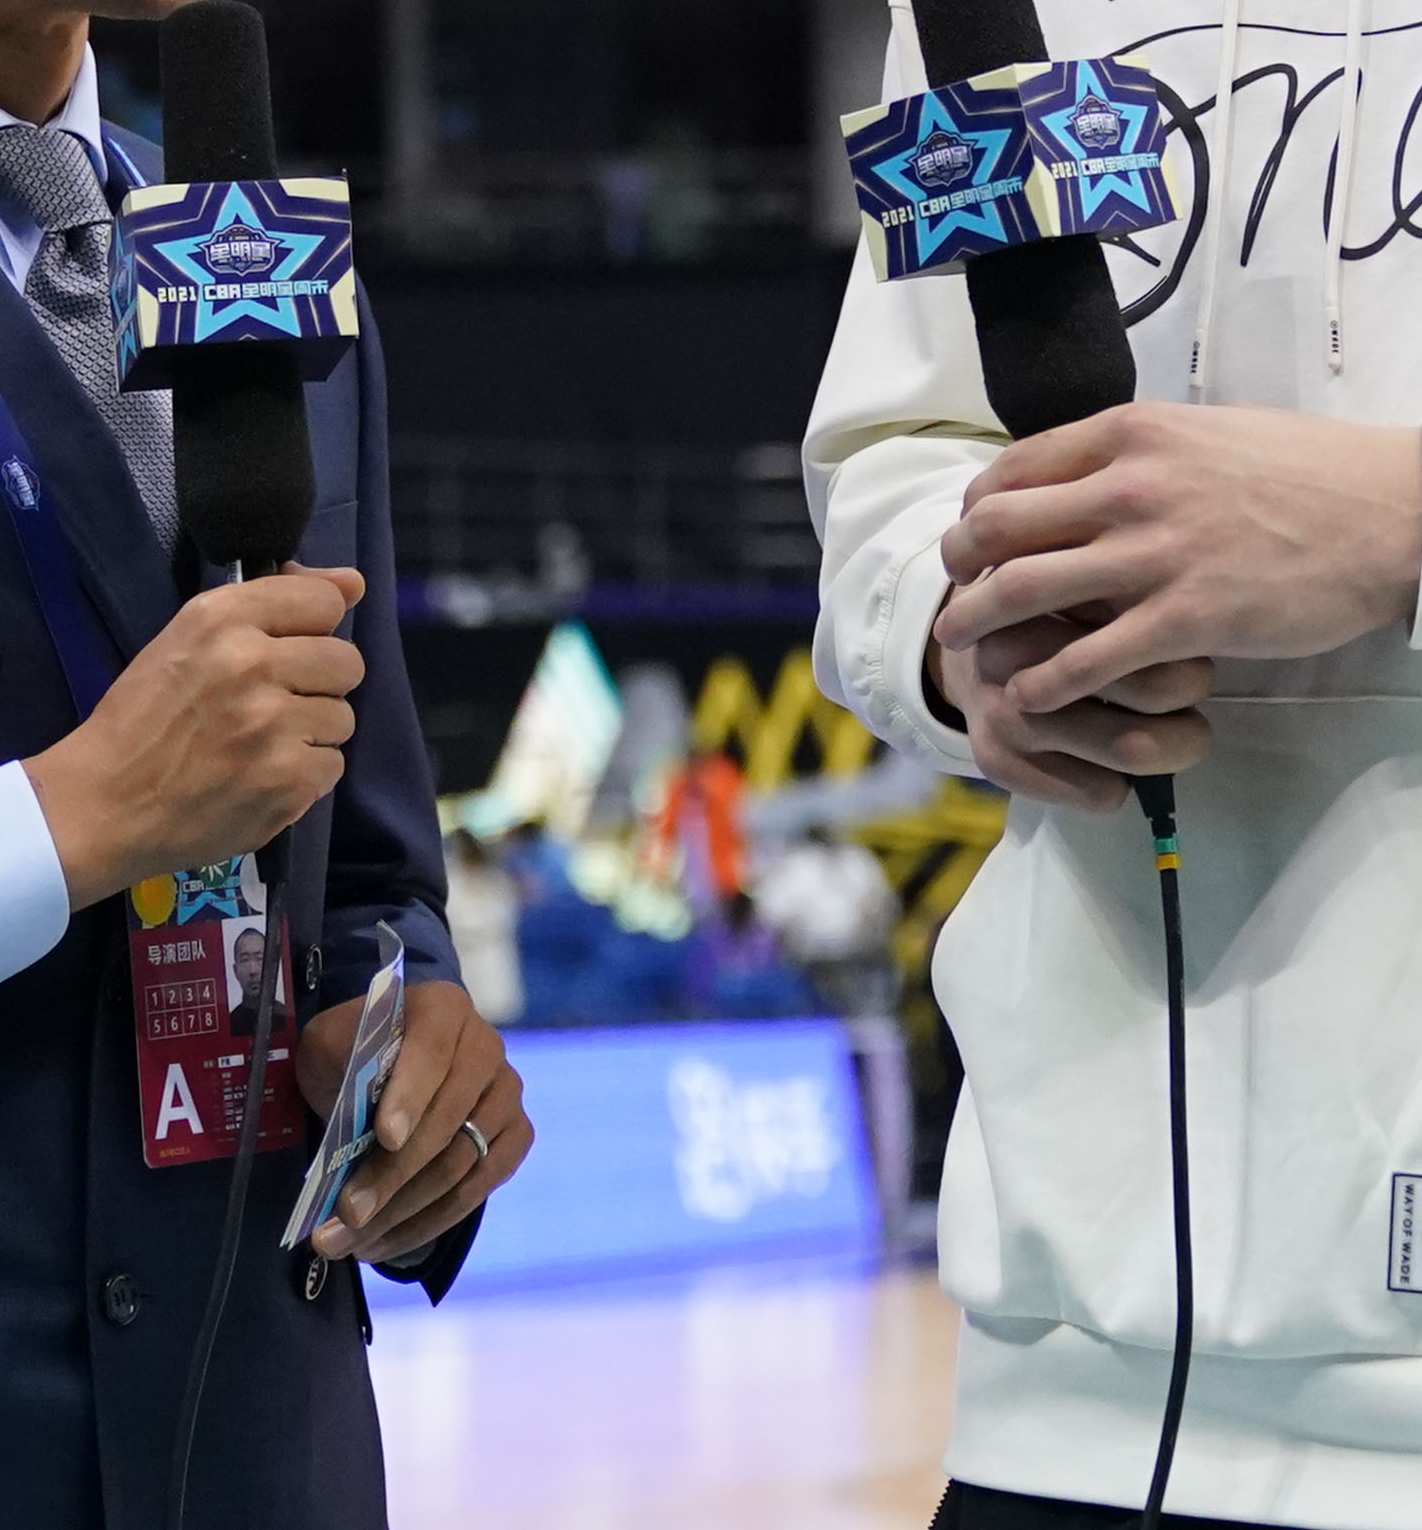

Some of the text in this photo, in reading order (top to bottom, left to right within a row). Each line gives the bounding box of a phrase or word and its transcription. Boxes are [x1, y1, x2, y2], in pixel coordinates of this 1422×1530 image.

[1050, 161, 1078, 180] 2021
[881, 205, 916, 228] 2021
[157, 286, 197, 303] 2021
[147, 939, 207, 966] 导演团队
[152, 985, 211, 1007] 1 2 3 4
[153, 1012, 213, 1034] 5 6 7 8
[155, 1062, 204, 1140] A
[1400, 1183, 1414, 1284] WAY OF WADE
